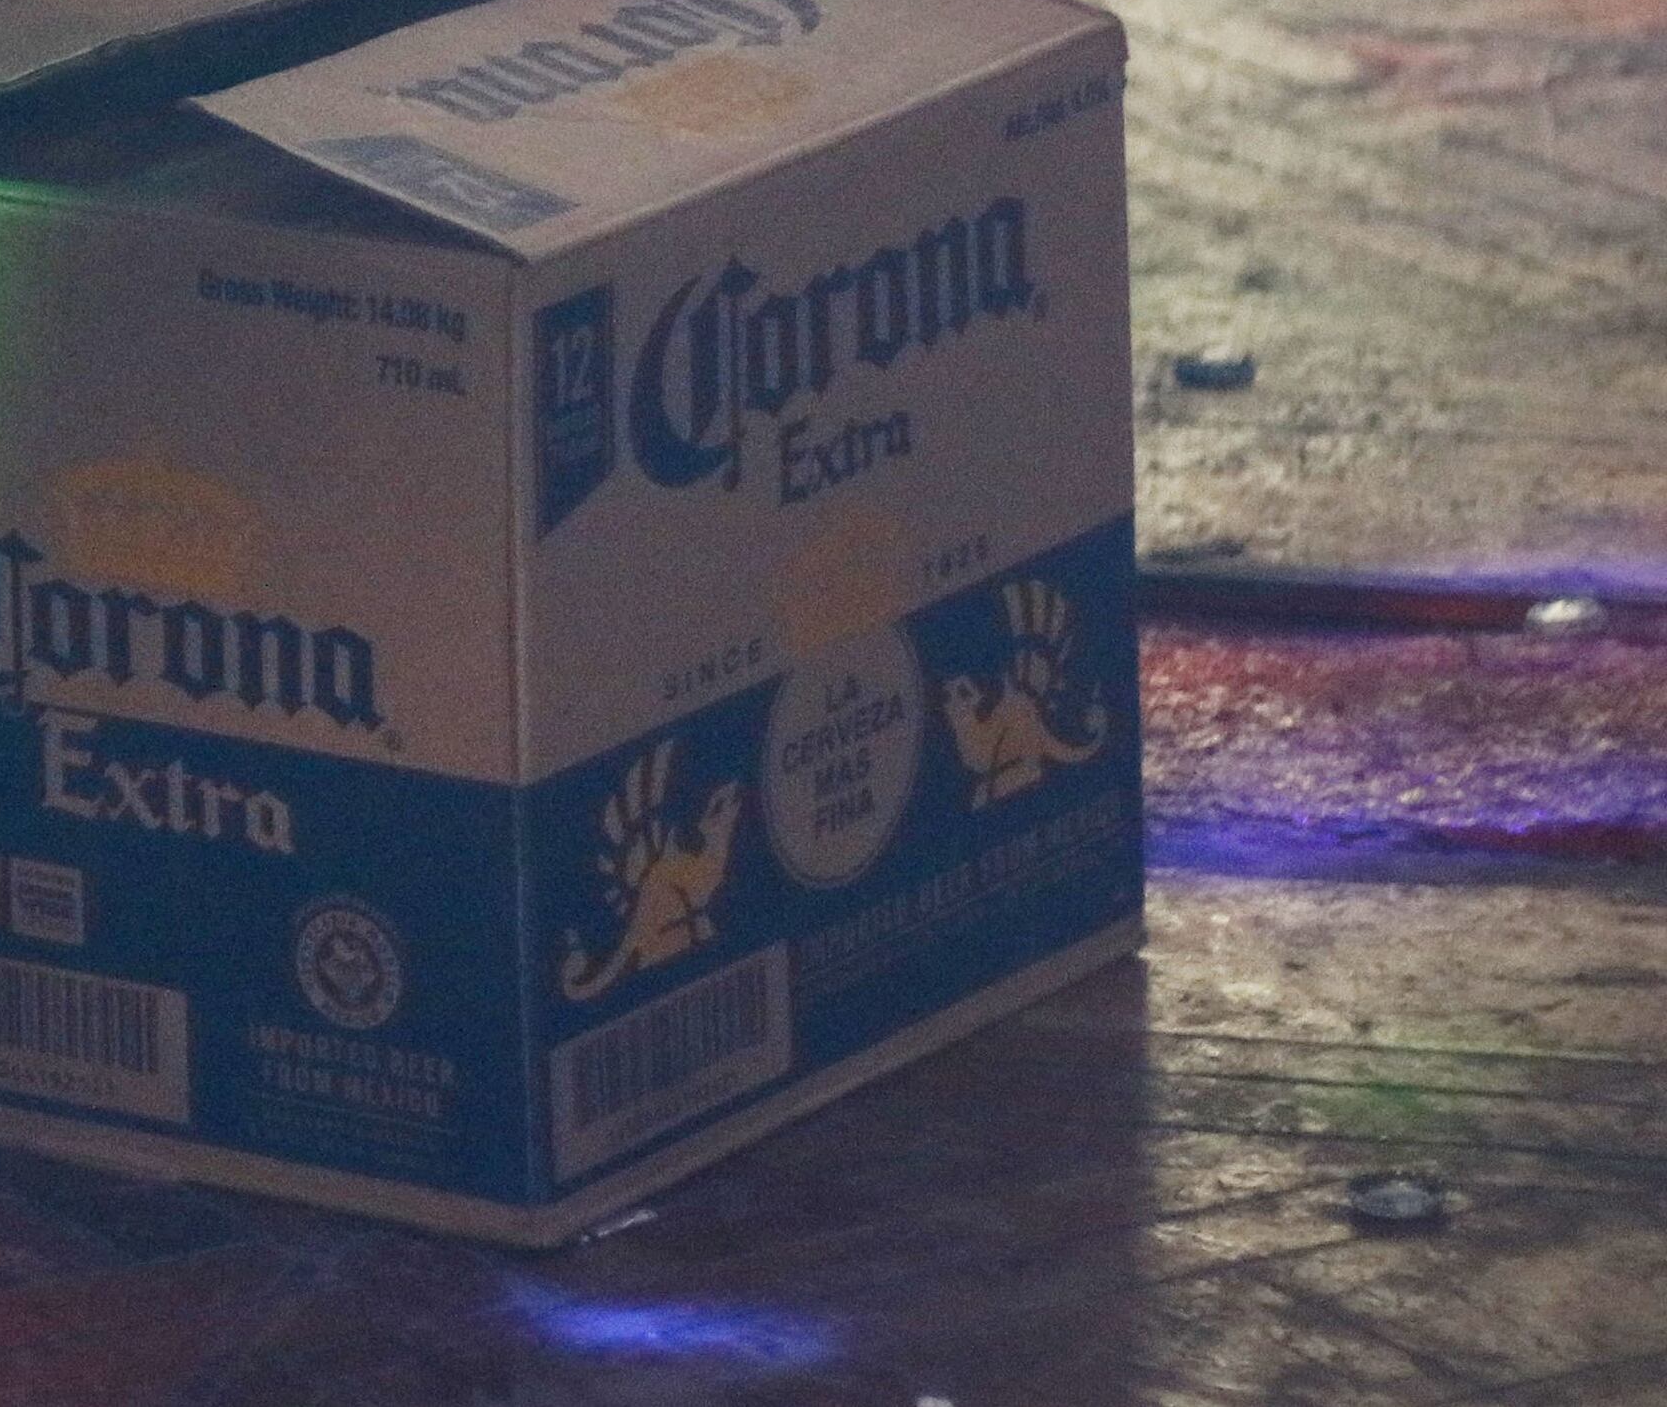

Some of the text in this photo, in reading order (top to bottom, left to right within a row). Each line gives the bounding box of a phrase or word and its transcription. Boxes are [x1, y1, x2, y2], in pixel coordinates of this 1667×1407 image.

[375, 353, 422, 389] 710
[550, 323, 596, 409] 12
[629, 195, 1035, 493] Corona
[780, 410, 913, 507] Extra
[662, 635, 764, 703] SINCE
[823, 674, 862, 715] LA
[780, 690, 907, 776] CERVEZA
[813, 745, 872, 798] MAS
[37, 706, 297, 856] Extra
[813, 785, 877, 841] FINA
